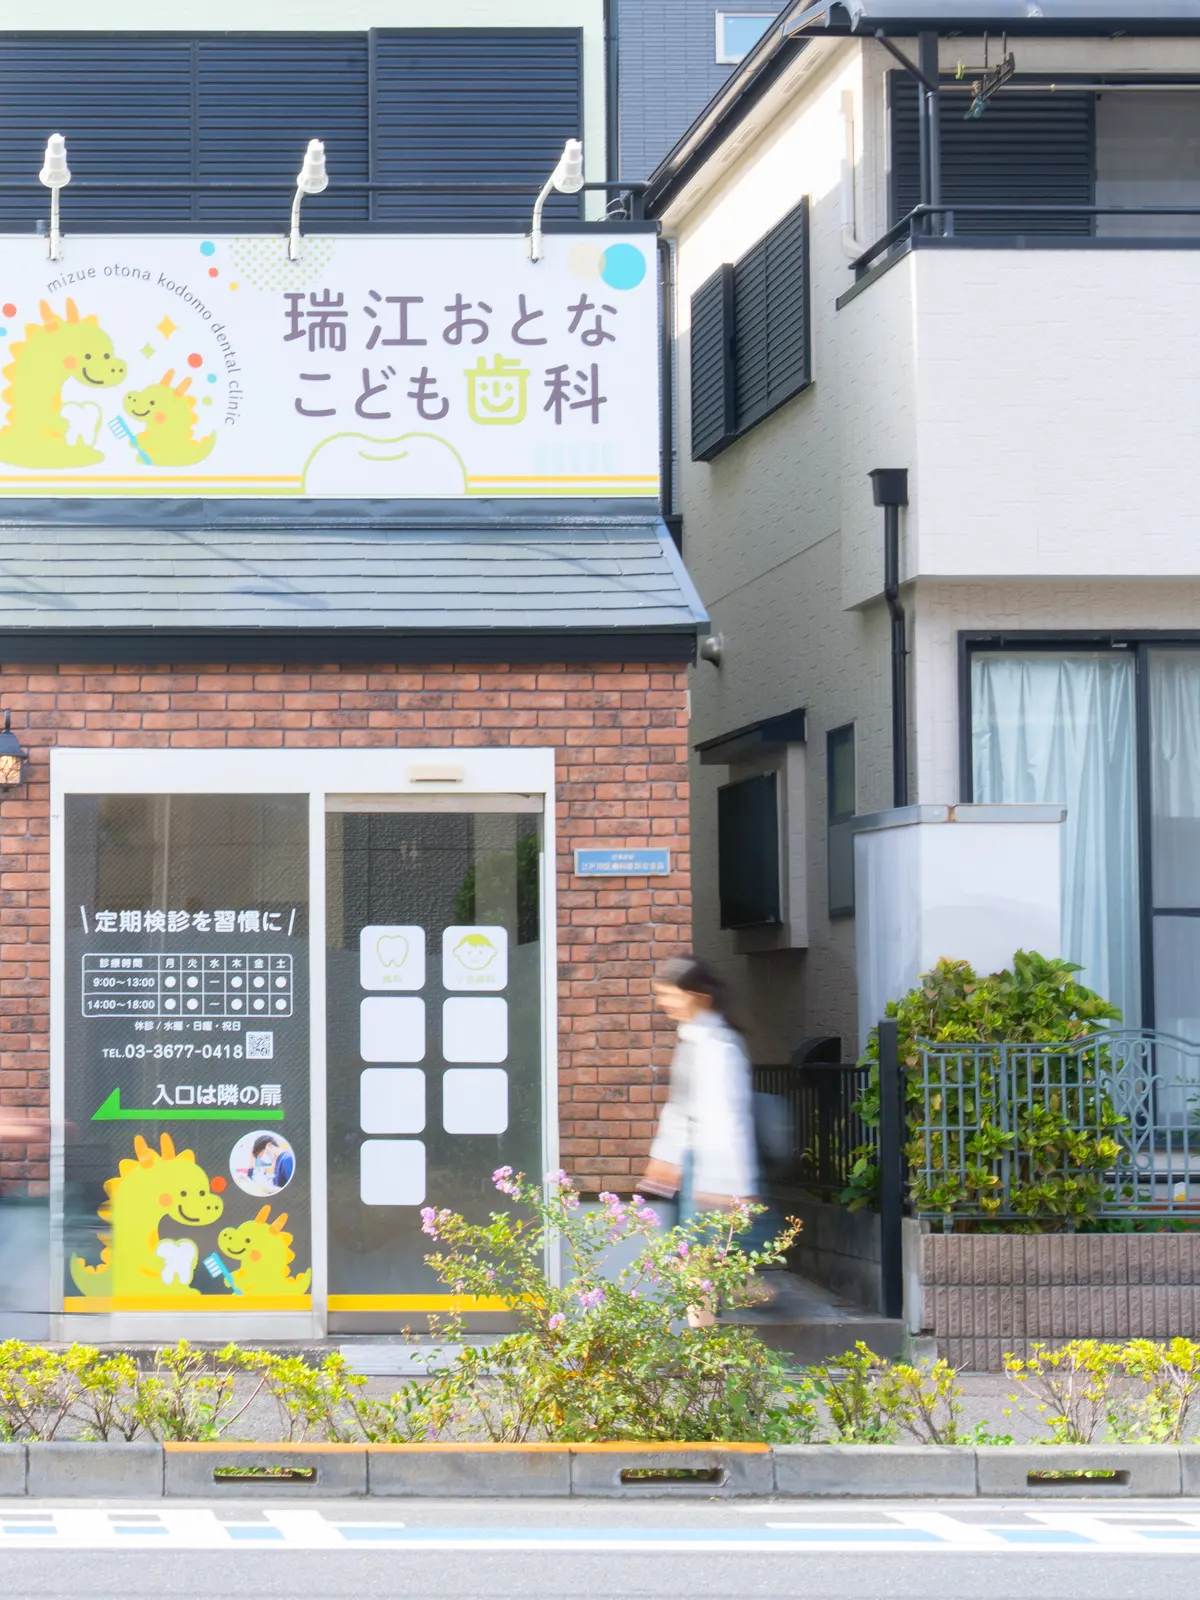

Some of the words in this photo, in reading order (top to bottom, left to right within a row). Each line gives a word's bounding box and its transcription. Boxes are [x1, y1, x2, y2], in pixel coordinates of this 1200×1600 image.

[46, 266, 97, 293] mizue
[103, 263, 151, 281] otona
[156, 272, 212, 321] kodomo
[283, 288, 618, 352] 瑞江おとな
[210, 322, 241, 374] dental
[224, 380, 243, 426] clinic
[294, 353, 608, 425] こども歯科
[94, 910, 283, 933] 定期検診を習慣に
[99, 958, 144, 969] 診療時間
[165, 958, 176, 969] 月
[187, 958, 198, 969] 火
[209, 958, 220, 969] 水
[231, 958, 242, 969] 木
[253, 958, 264, 969] 金
[275, 958, 286, 969] 土
[152, 1084, 282, 1106] 入口は隣の扉
